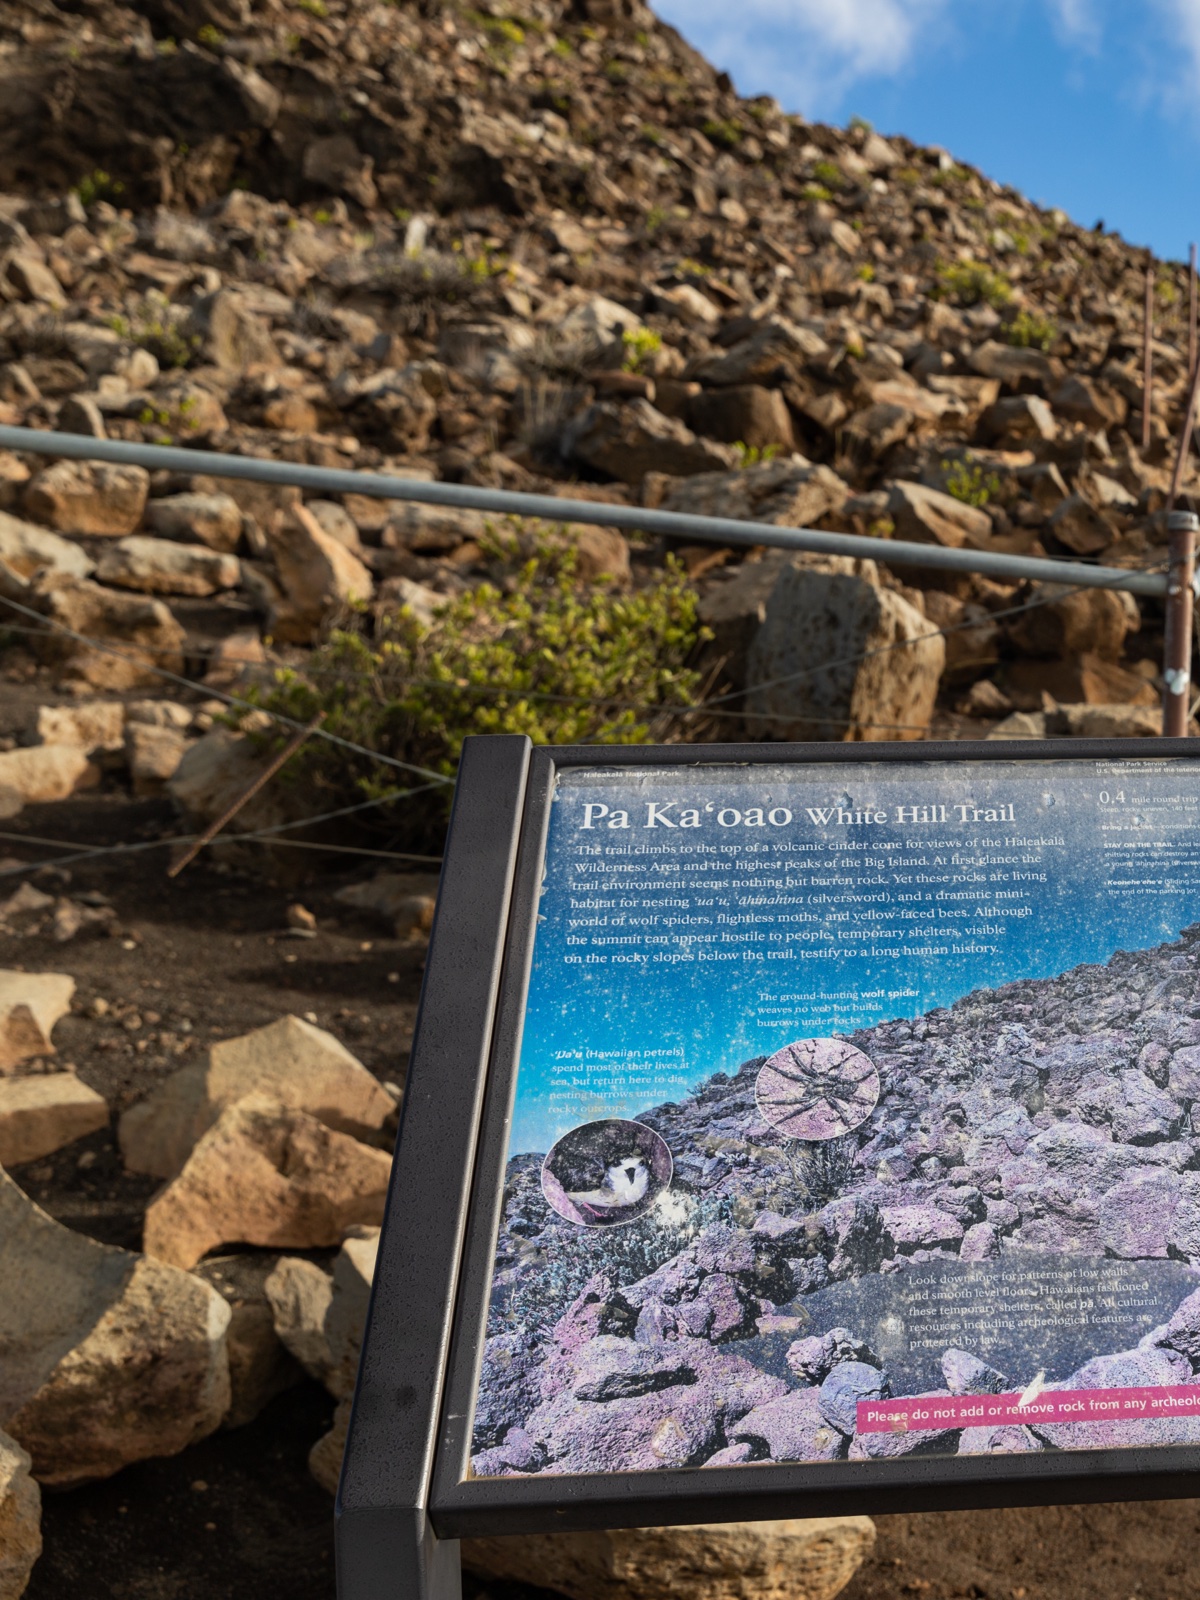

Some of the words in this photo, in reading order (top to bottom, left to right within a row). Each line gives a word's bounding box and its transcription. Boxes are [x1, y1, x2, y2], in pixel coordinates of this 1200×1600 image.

[1100, 791, 1126, 804] 0.4
[1182, 795, 1198, 804] trip
[579, 803, 630, 829] Pa
[805, 805, 887, 825] White
[896, 804, 947, 824] Hill
[954, 803, 1015, 823] Trail
[576, 846, 600, 855] The
[606, 845, 631, 854] trail
[634, 844, 676, 854] climbs
[680, 845, 692, 853] to
[697, 843, 716, 853] the
[720, 844, 741, 855] top
[746, 843, 759, 852] of
[773, 841, 824, 851] volcanic
[829, 840, 868, 850] cinder
[906, 839, 923, 849] for
[927, 839, 962, 848] views
[965, 838, 978, 848] of
[982, 838, 1001, 847] the
[575, 861, 646, 872] Wilderness
[650, 861, 680, 870] Area
[683, 860, 708, 870] and
[712, 860, 731, 869] the
[736, 859, 781, 871] highest
[785, 858, 820, 870] peaks
[824, 857, 837, 867] of
[841, 857, 860, 866] the
[865, 857, 884, 868] Big
[889, 856, 929, 865] Island.
[934, 855, 948, 865] At
[951, 855, 975, 864] first
[979, 854, 1018, 866] glance
[1022, 853, 1041, 863] the
[572, 880, 598, 890] trail
[602, 879, 685, 889] environment
[690, 880, 728, 888] seems
[732, 877, 782, 889] nothing
[786, 876, 807, 886] but
[811, 875, 852, 885] barren
[857, 874, 889, 884] rock.
[893, 874, 912, 883] Yet
[916, 873, 949, 883] these
[953, 872, 986, 882] rocks
[1013, 871, 1047, 883] living
[570, 898, 615, 908] habitat
[620, 897, 638, 907] for
[642, 896, 689, 909] nesting
[808, 891, 894, 905] (silversword),
[898, 891, 921, 900] and
[936, 889, 991, 900] dramatic
[995, 888, 1030, 898] mini-
[569, 916, 607, 926] world
[611, 916, 626, 925] of
[629, 915, 658, 924] wolf
[663, 914, 713, 926] spiders,
[717, 912, 774, 925] flightless
[778, 911, 822, 923] moths,
[825, 911, 848, 920] and
[852, 909, 934, 922] yellow-faced
[939, 908, 969, 918] bees.
[974, 907, 1032, 919] Although
[566, 935, 588, 944] the
[592, 934, 641, 944] summit
[673, 934, 717, 944] appear
[722, 931, 765, 941] hostile
[769, 932, 781, 940] to
[786, 929, 834, 942] people,
[838, 929, 904, 940] temporary
[909, 926, 962, 938] shelters,
[965, 925, 1006, 935] visible
[586, 953, 607, 963] the
[611, 952, 649, 965] rocky
[653, 951, 694, 964] slopes
[698, 950, 737, 960] below
[742, 949, 763, 959] the
[767, 949, 797, 960] trail,
[800, 948, 840, 960] testify
[844, 948, 857, 957] to
[871, 946, 900, 958] long
[903, 945, 948, 955] human
[952, 944, 999, 956] history.
[758, 993, 777, 1001] The
[780, 991, 858, 1002] ground-hunting
[861, 990, 885, 998] wolf
[888, 989, 920, 999] spider
[811, 1004, 830, 1012] web
[834, 1004, 850, 1012] but
[853, 1003, 883, 1011] builds
[757, 1018, 799, 1027] burrows
[802, 1017, 830, 1025] under
[834, 1017, 861, 1025] rocks
[552, 1064, 583, 1074] spend
[628, 1062, 652, 1070] their
[655, 1061, 678, 1069] lives
[573, 1077, 590, 1085] but
[593, 1077, 625, 1085] return
[629, 1076, 651, 1084] here
[668, 1075, 683, 1085] dig
[550, 1091, 587, 1101] nesting
[590, 1090, 634, 1098] burrows
[636, 1089, 667, 1097] under
[909, 1275, 936, 1285] Look
[940, 1272, 998, 1285] downslope
[1002, 1272, 1016, 1281] for
[1020, 1271, 1062, 1282] patterns
[1066, 1269, 1078, 1278] of
[1080, 1268, 1099, 1277] low
[1102, 1267, 1128, 1276] walls
[964, 1319, 1015, 1331] including
[1018, 1315, 1089, 1329] archeological
[1091, 1314, 1133, 1324] features
[910, 1337, 961, 1350] protected
[965, 1336, 978, 1348] by
[868, 1409, 908, 1422] Please
[913, 1408, 929, 1420] do
[934, 1408, 955, 1419] not
[960, 1405, 984, 1417] add
[989, 1407, 1002, 1416] or
[1006, 1404, 1054, 1415] remove
[1058, 1400, 1085, 1412] rock
[1089, 1398, 1119, 1411] from
[1124, 1400, 1146, 1412] any
